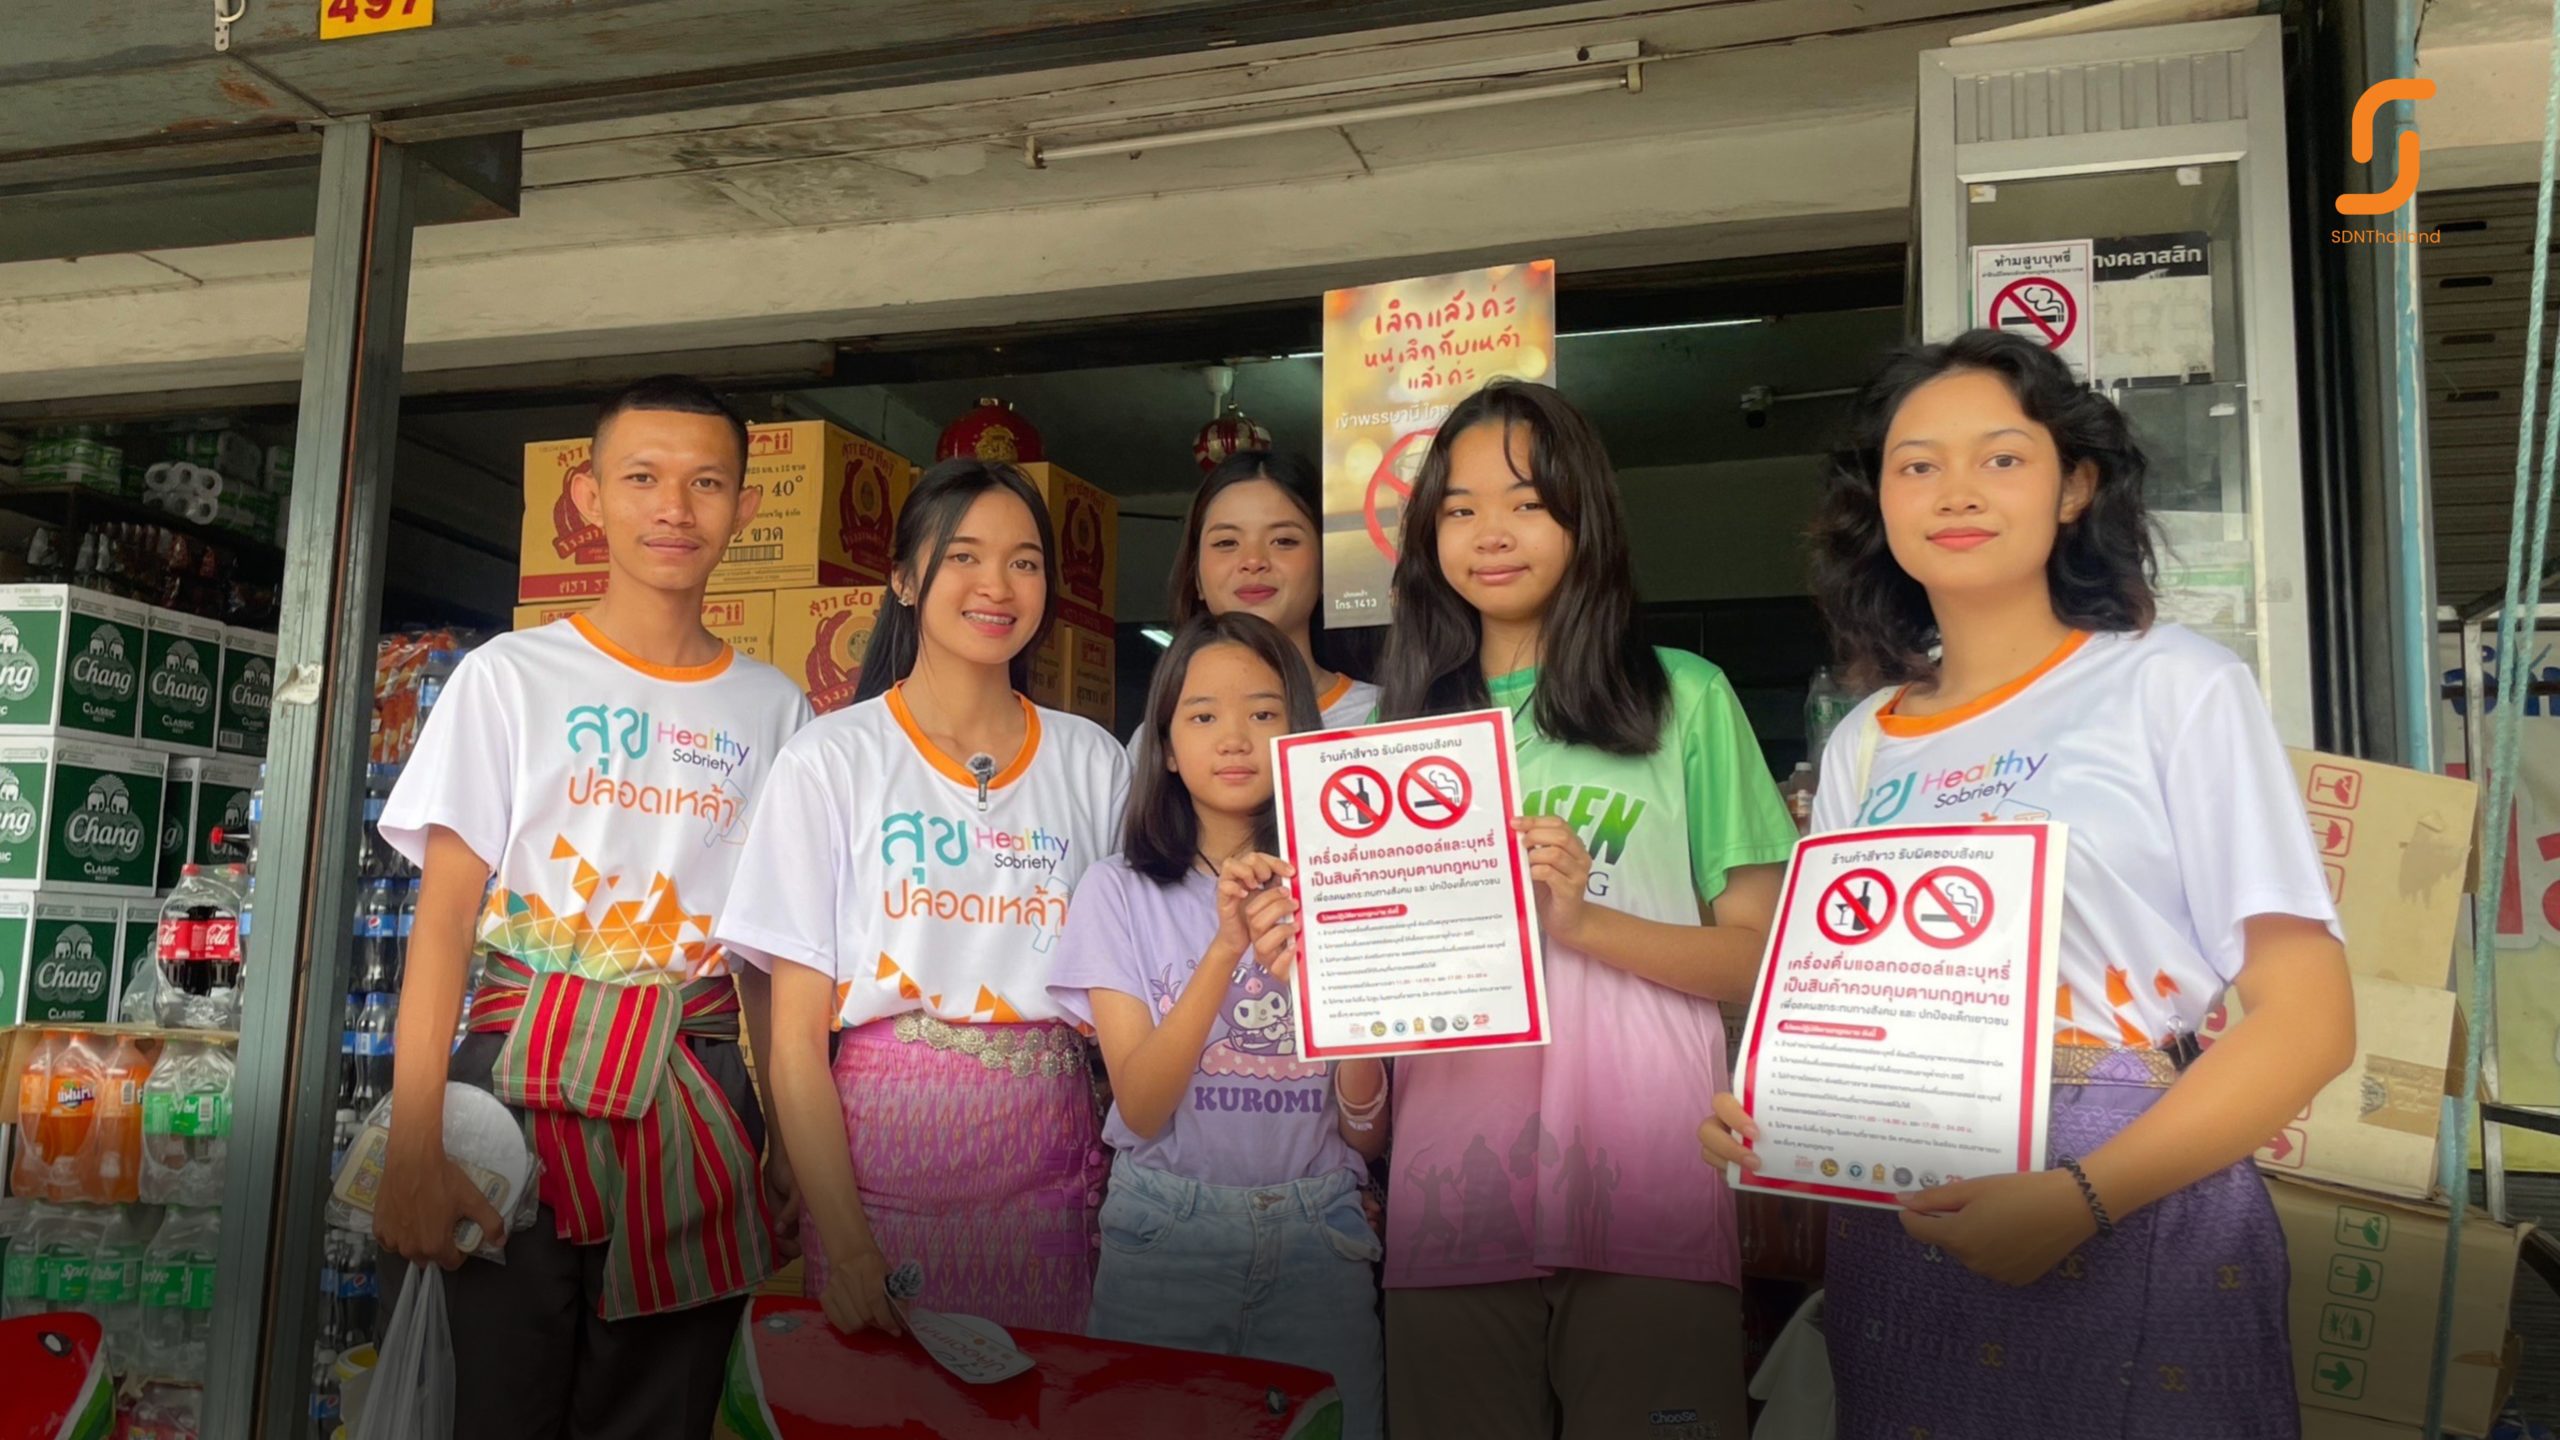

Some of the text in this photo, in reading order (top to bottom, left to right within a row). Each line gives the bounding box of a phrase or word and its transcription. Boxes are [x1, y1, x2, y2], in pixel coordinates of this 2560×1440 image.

[2092, 245, 2202, 268] างคลาสสิก
[750, 526, 784, 543] ขวด
[0, 666, 33, 692] ng
[73, 656, 132, 695] Chang
[152, 671, 209, 707] Chang
[566, 704, 649, 775] สุข
[657, 721, 750, 766] Healthy
[1319, 737, 1463, 764] ร้านค้าสีขาว รับผิดชอบสังคม
[672, 748, 734, 777] Sobriety
[1920, 749, 2049, 794] Healthy
[568, 767, 738, 828] ปลอดเหล้า
[1934, 781, 2017, 809] Sobriety
[68, 814, 141, 853] Chang
[881, 810, 969, 885] สุข
[974, 827, 1069, 861] Healthy
[1308, 828, 1496, 866] เครื่องดื่มแอลกอฮอล์และบุหรี่
[84, 862, 120, 876] CLASSIC
[994, 853, 1057, 875] Sobriety
[1831, 847, 1994, 865] ร้านค้าสีขาว รับผิดชอบสังคม
[1311, 857, 1499, 888] เป็นสินค้าควบคุมตามกฎหมาย
[884, 878, 1067, 927] ปลอดเหล้า
[38, 962, 102, 994] Chang
[1787, 950, 2012, 984] เครื่องดื่มแอลกอฮอล์และบุหรี่
[1783, 977, 2010, 1006] เป็นสินค้าควบคุมตามกฎหมาย
[1194, 1086, 1322, 1113] KUROMI
[61, 1262, 90, 1281] Spri
